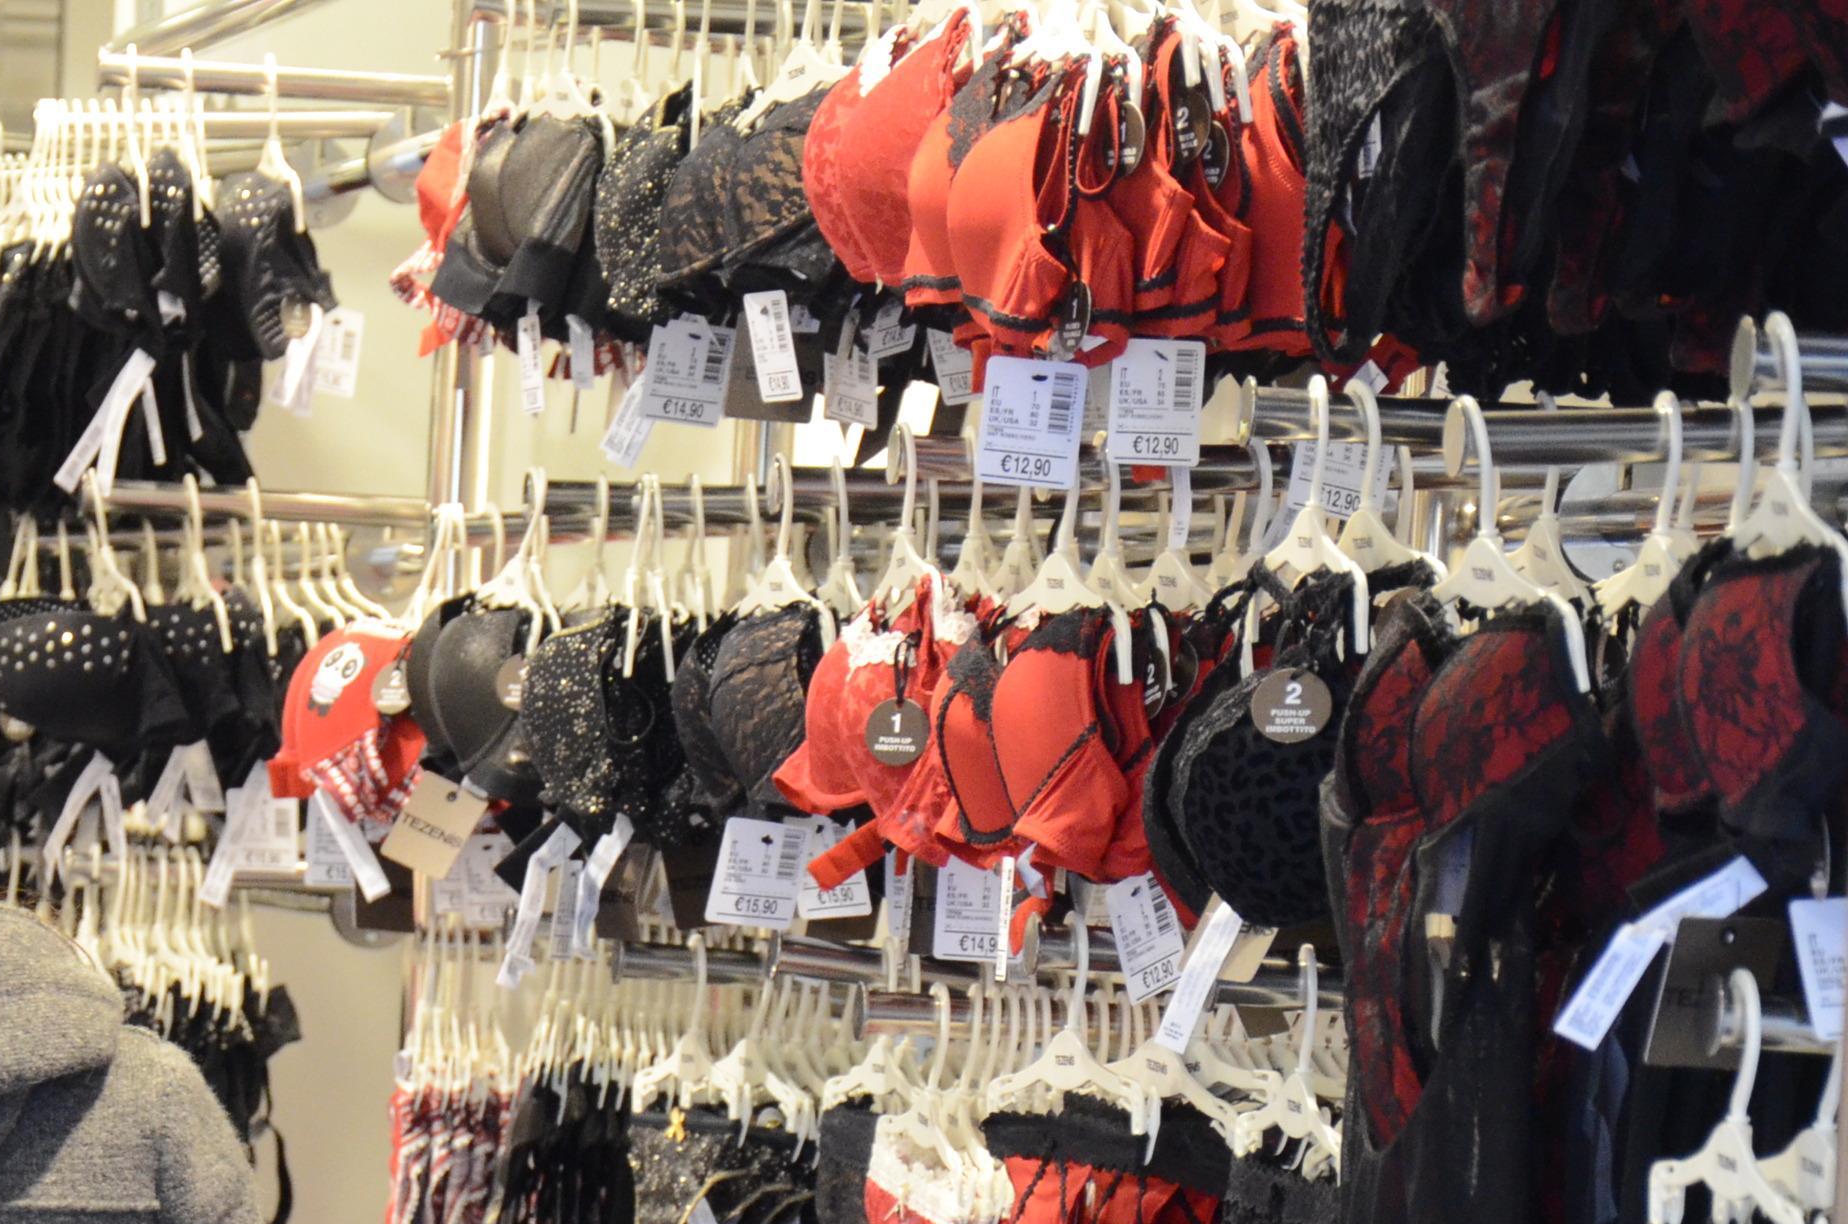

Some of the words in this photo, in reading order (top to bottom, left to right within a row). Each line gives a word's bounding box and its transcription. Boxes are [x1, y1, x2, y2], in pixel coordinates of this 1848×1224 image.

[1132, 435, 1179, 457] €12,90
[1001, 454, 1052, 478] €12,90
[1321, 486, 1361, 512] 12,90
[1285, 682, 1303, 705] 2
[891, 712, 902, 733] 1
[1265, 725, 1316, 734] IMBOTTITO
[1274, 717, 1306, 725] SUPER
[734, 896, 778, 915] €15,90
[959, 934, 998, 956] €14,9
[1142, 959, 1174, 989] €12,90
